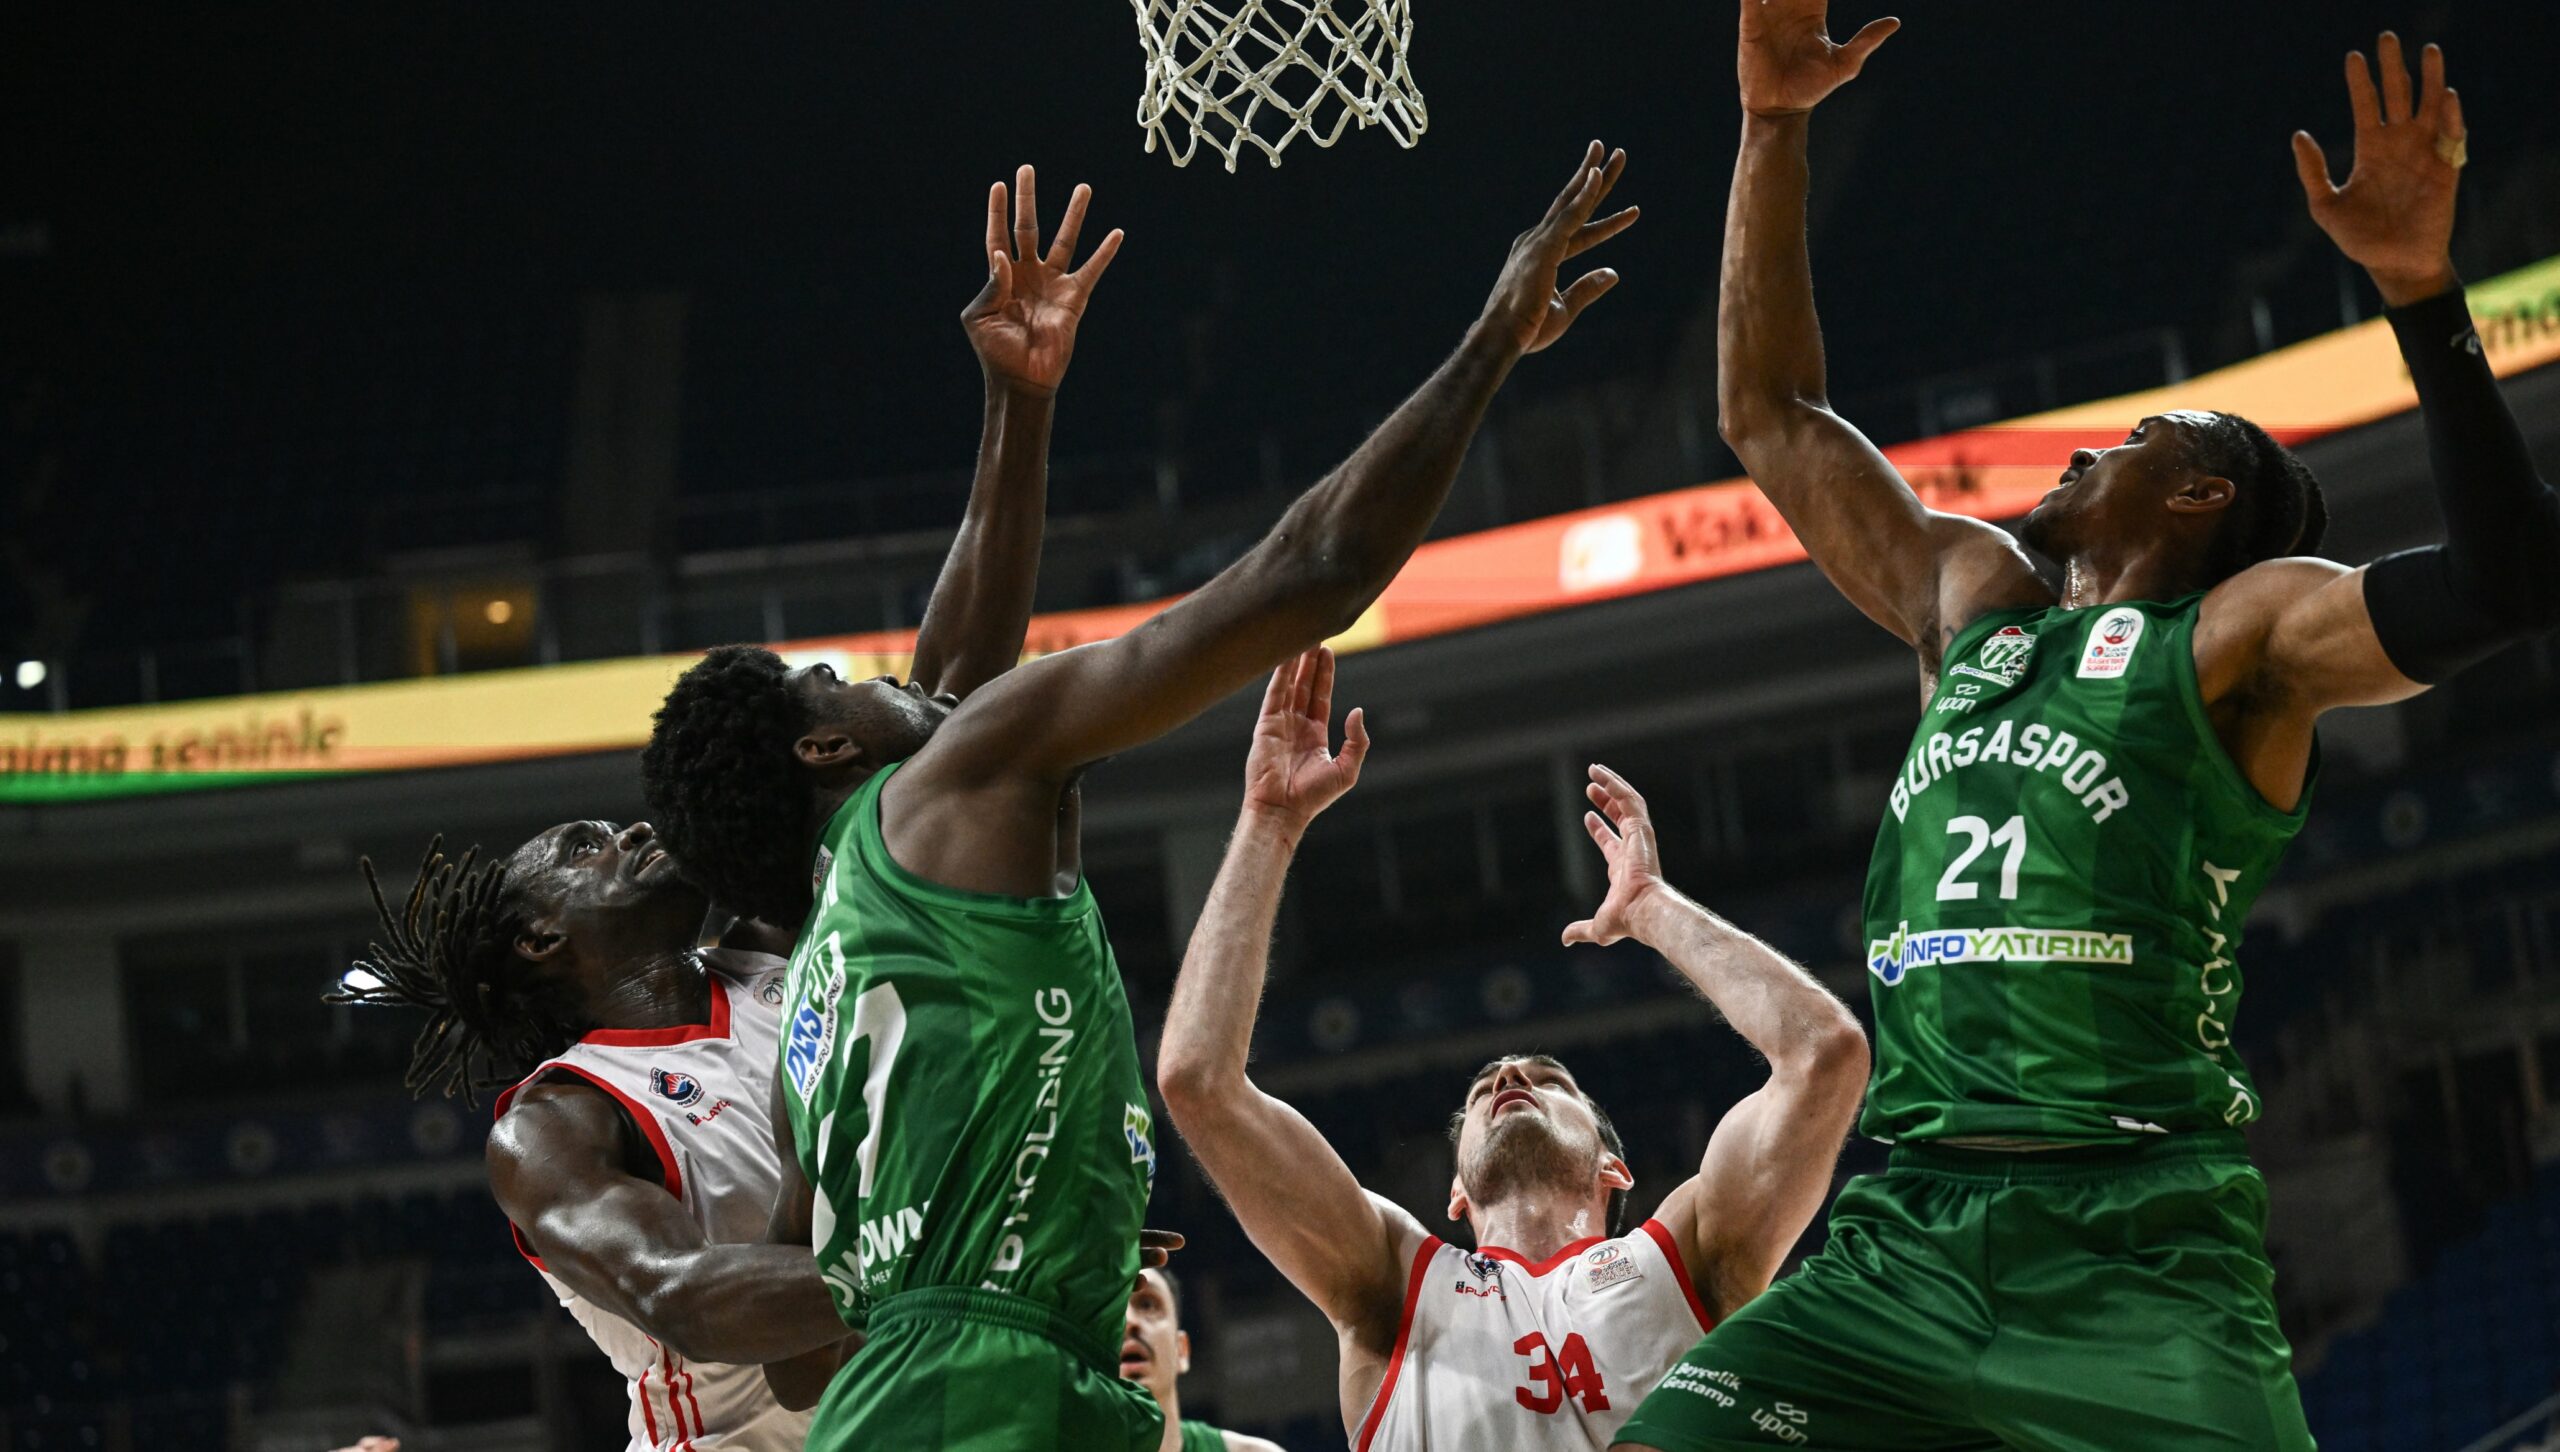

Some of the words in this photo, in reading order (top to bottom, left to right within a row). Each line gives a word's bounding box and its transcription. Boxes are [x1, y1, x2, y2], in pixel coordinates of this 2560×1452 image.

[1890, 719, 2130, 824] BURSASPOR
[1935, 815, 2027, 901] 21
[1513, 1331, 1611, 1415] 34
[1751, 1408, 1808, 1448] upon
